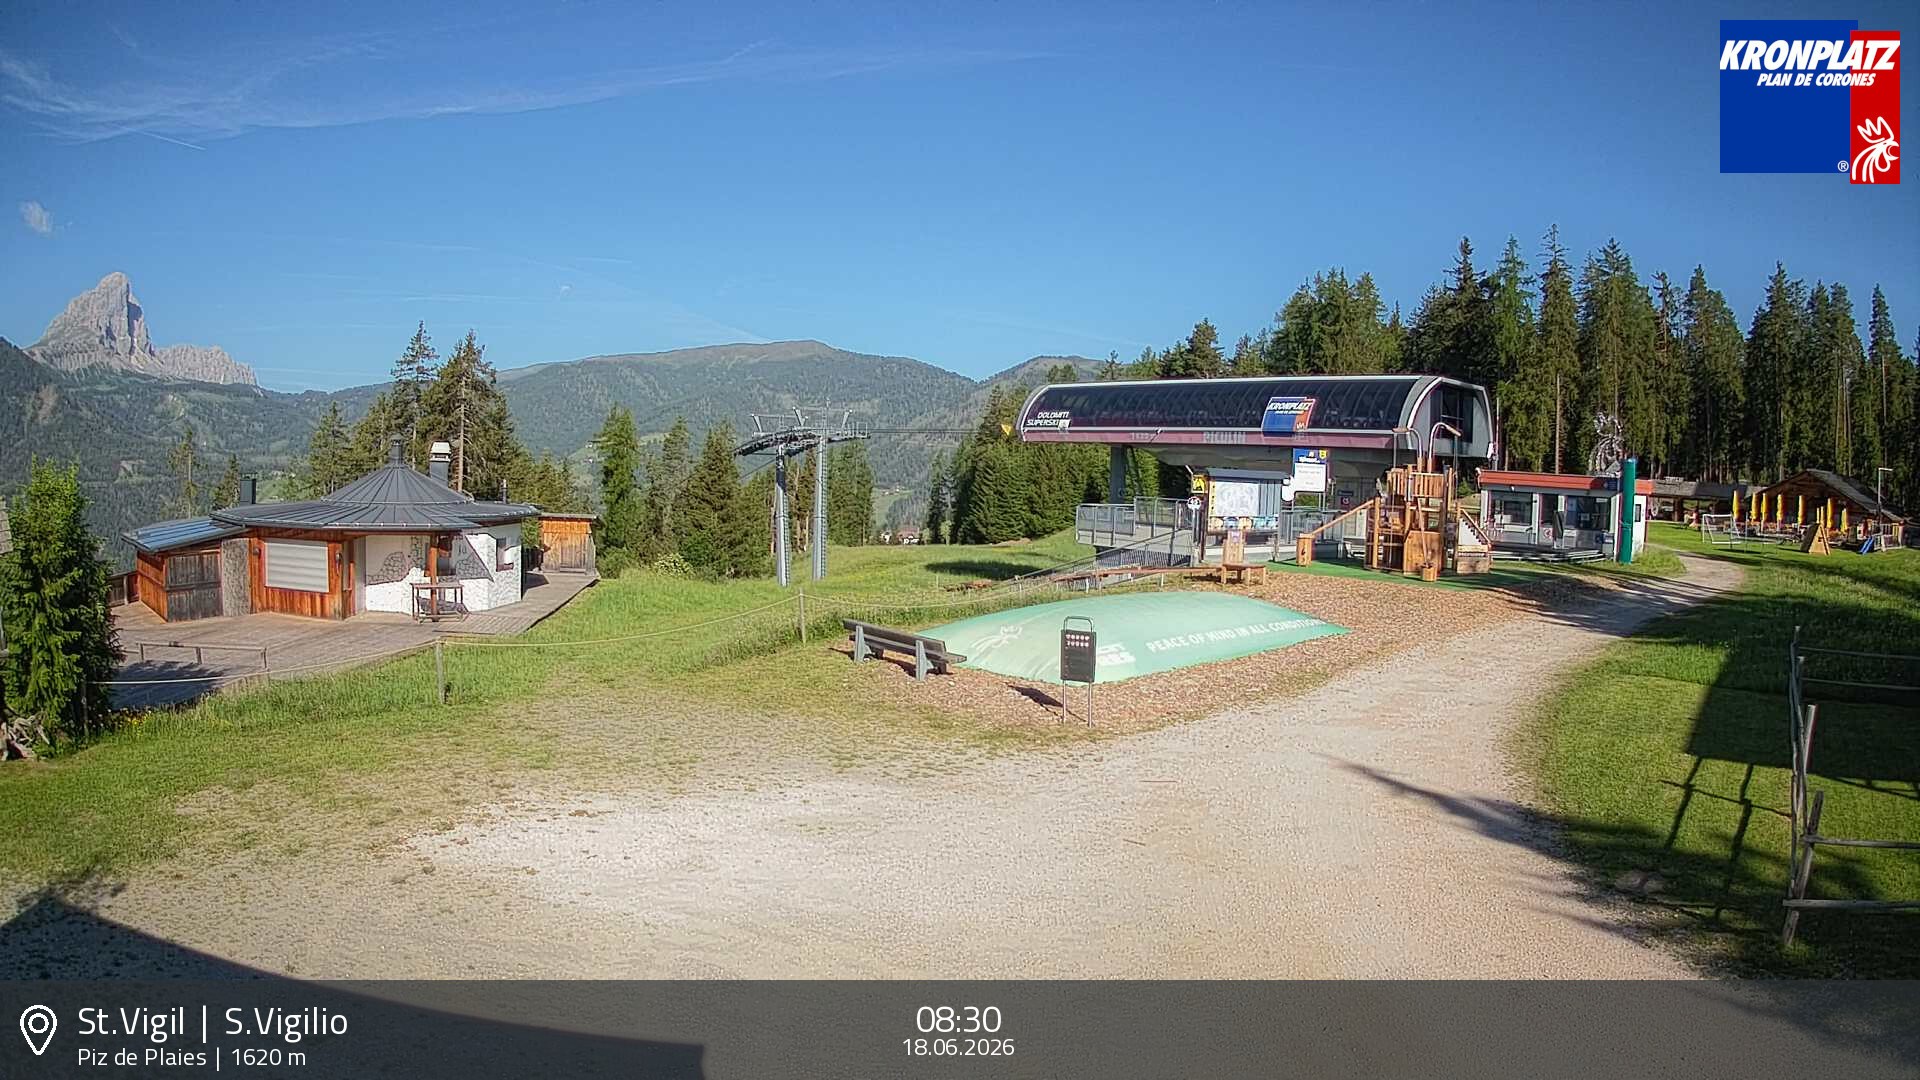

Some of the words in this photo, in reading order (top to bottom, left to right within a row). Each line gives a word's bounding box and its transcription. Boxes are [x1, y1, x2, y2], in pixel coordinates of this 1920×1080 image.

[1037, 411, 1070, 419] DOLOMITI
[1145, 635, 1190, 653] PEACE
[1188, 634, 1206, 646] OF
[1205, 629, 1236, 643] MIND
[1234, 627, 1250, 639] IN
[1249, 624, 1270, 636] ALL
